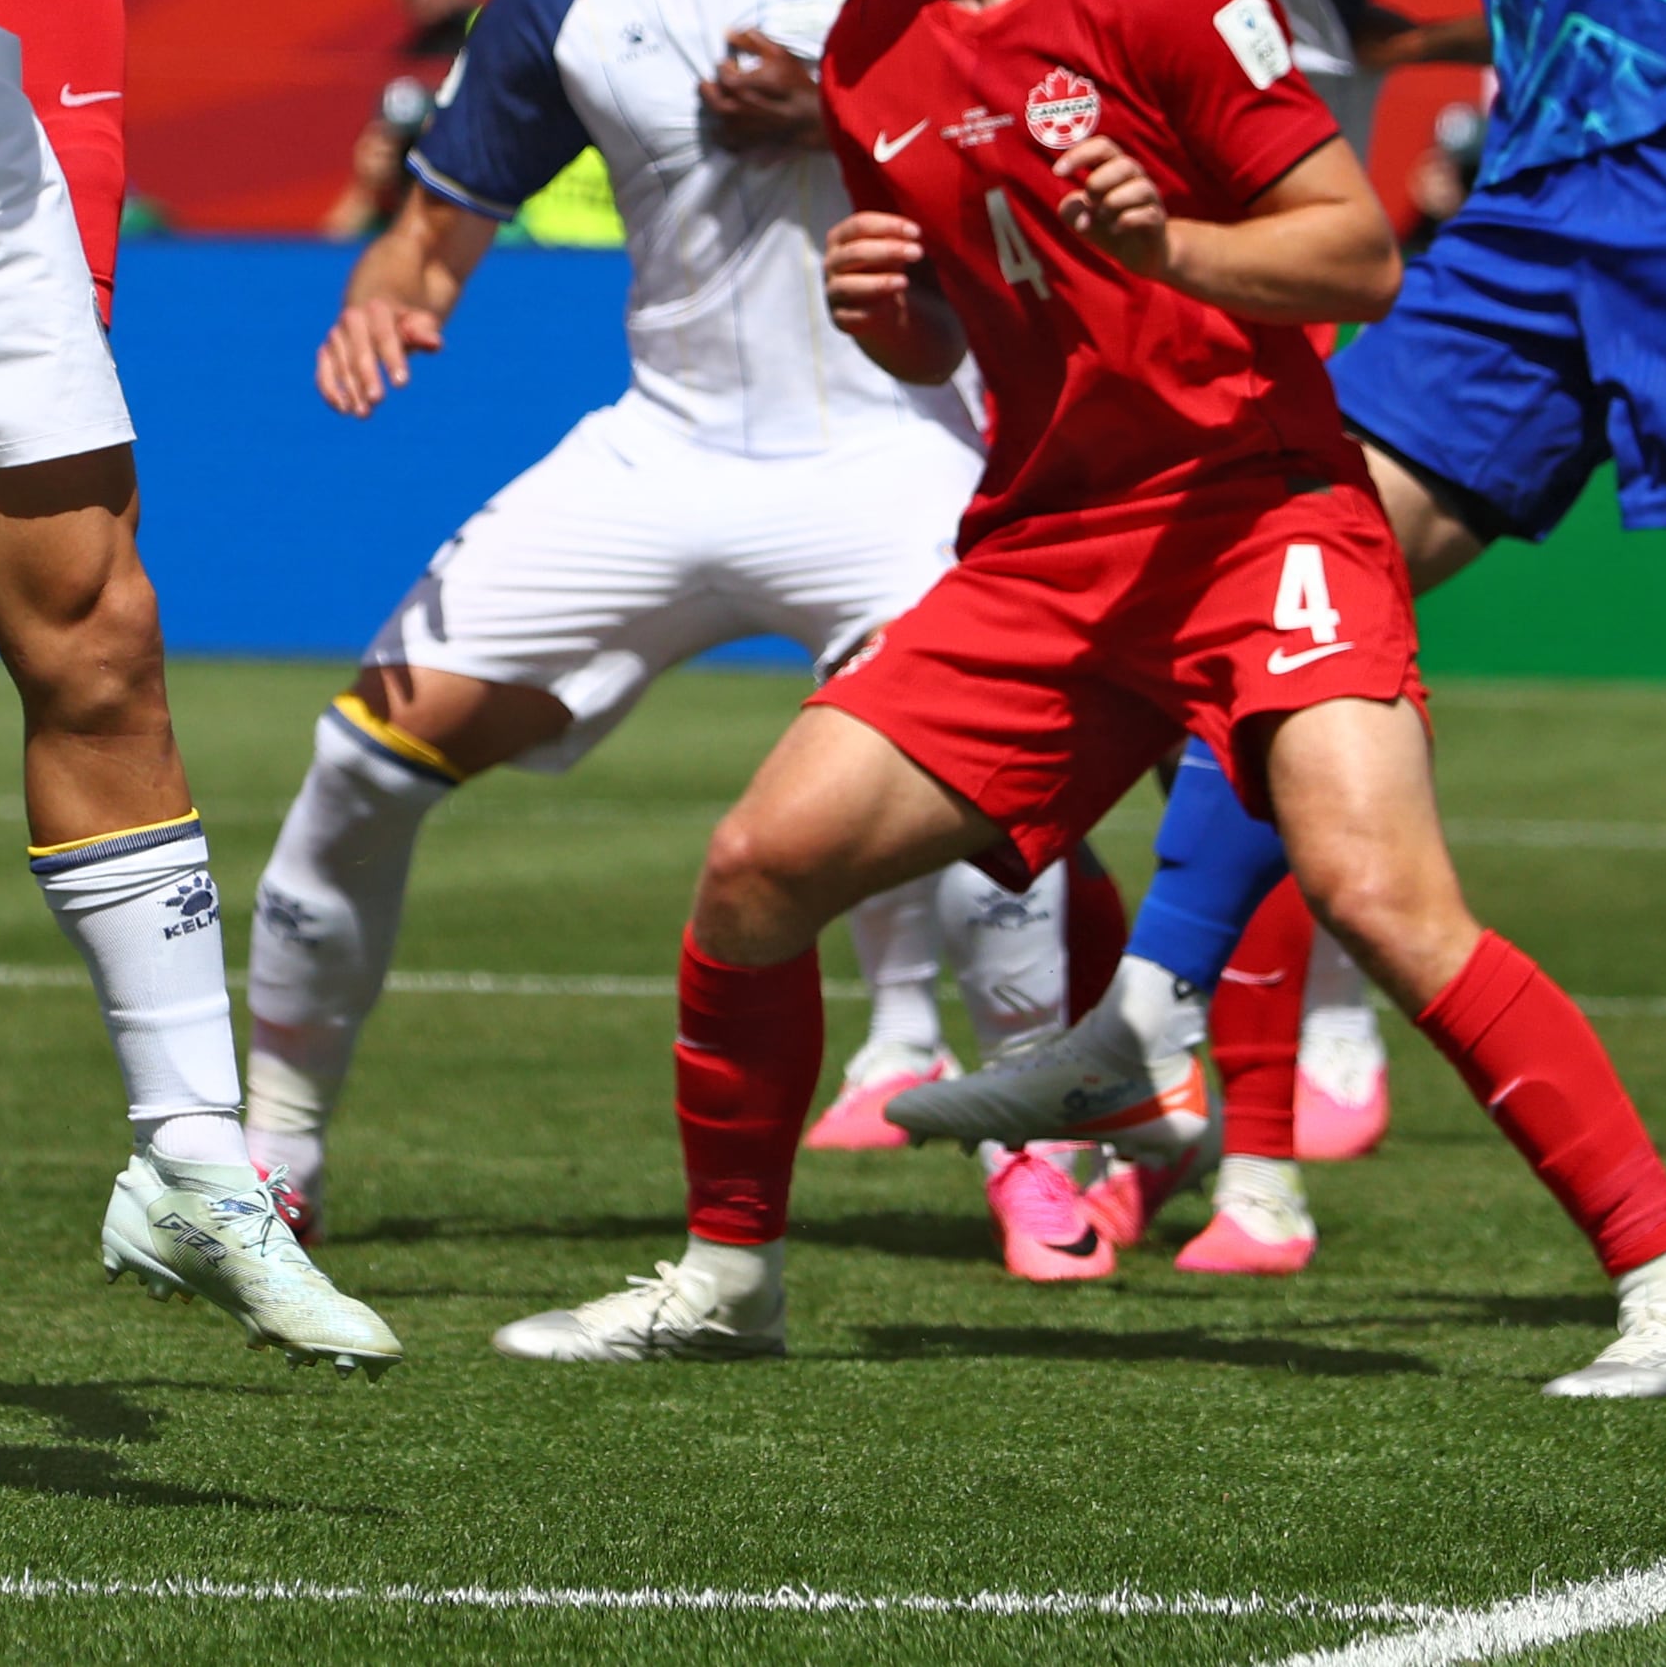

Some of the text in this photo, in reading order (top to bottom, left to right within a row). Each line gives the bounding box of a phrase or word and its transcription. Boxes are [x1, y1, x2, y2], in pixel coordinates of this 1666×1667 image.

[985, 187, 1051, 301] 4
[1273, 543, 1342, 644] 4
[163, 903, 220, 941] KELM
